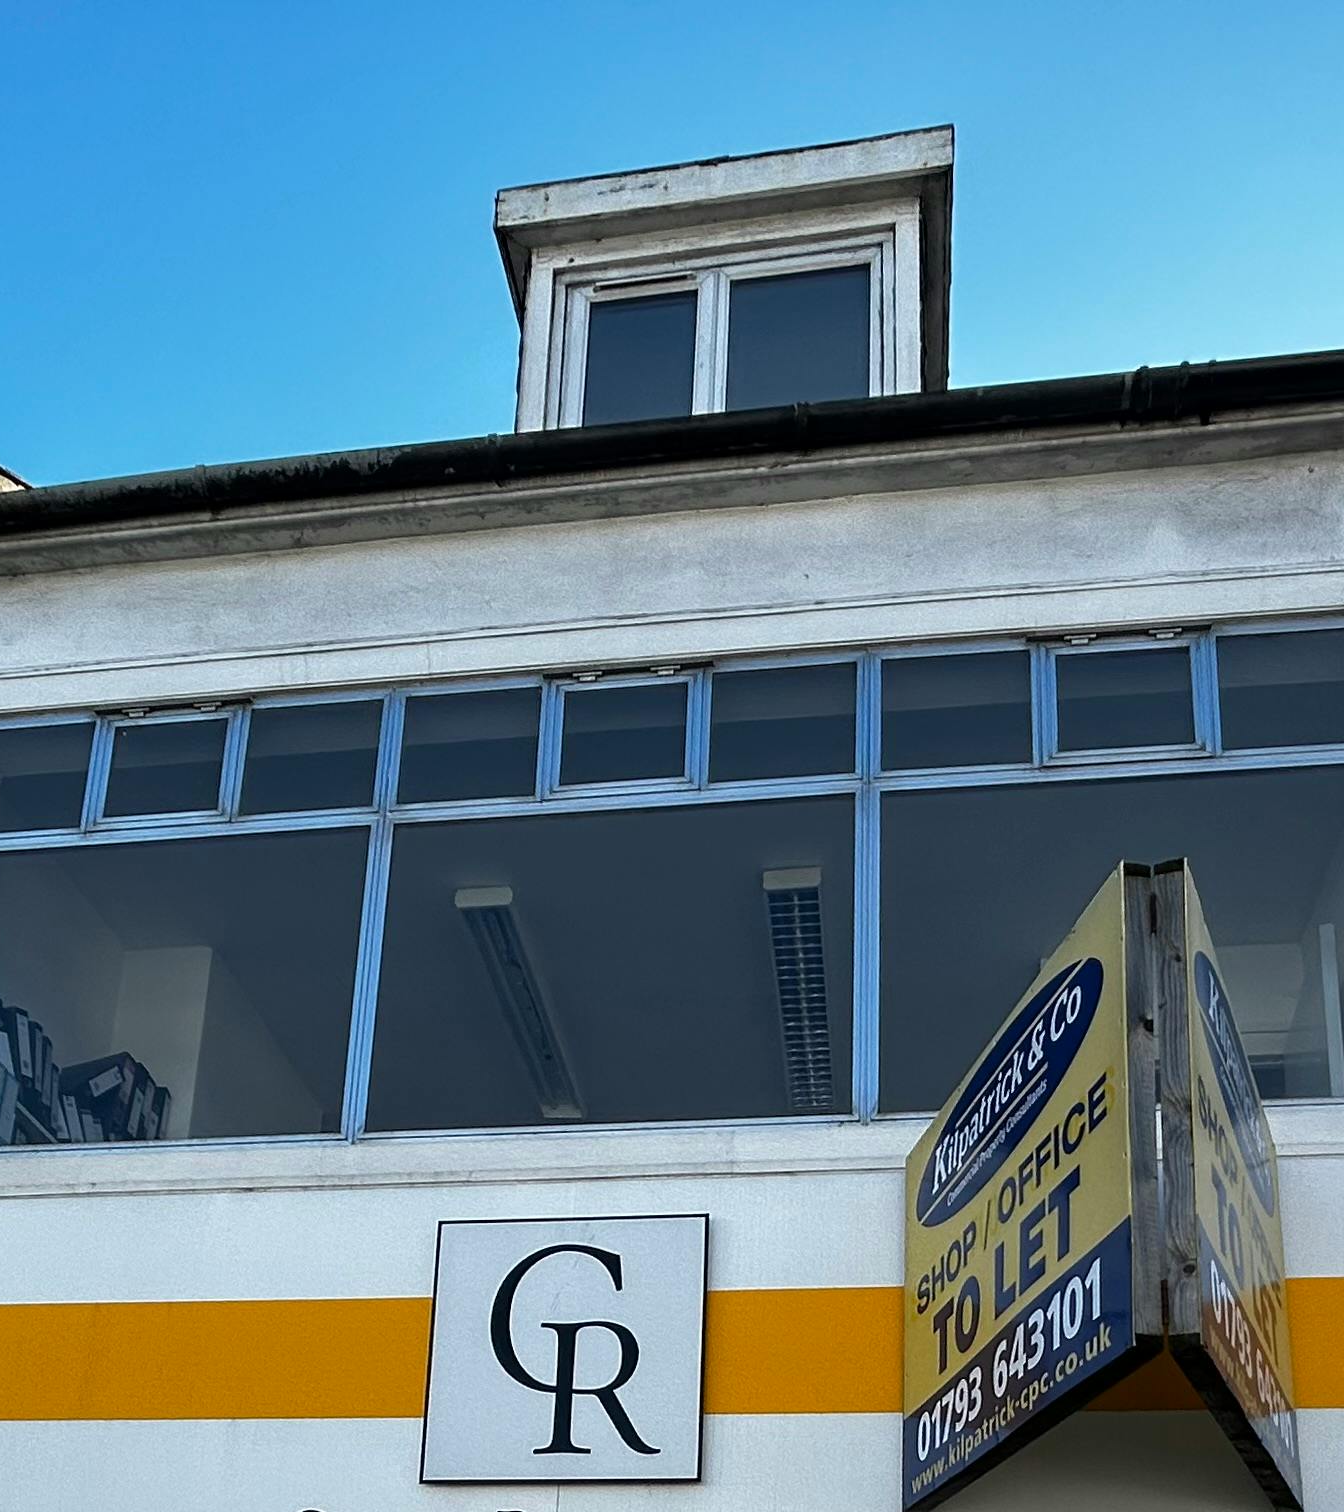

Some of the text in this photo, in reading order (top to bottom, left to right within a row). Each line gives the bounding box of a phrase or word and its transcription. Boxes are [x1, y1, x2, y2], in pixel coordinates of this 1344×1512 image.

[932, 984, 1082, 1195] Kilpatrick & Co
[1197, 1073, 1237, 1188] SHOP
[916, 1215, 976, 1320] SHOP
[997, 1072, 1108, 1226] OFFICE
[933, 1162, 1080, 1381] TO LET
[1211, 1160, 1244, 1290] TO
[1250, 1235, 1279, 1368] LET
[911, 1323, 1112, 1497] www.kilpatrick-cpc.co.uk
[917, 1362, 983, 1464] 01793
[992, 1257, 1103, 1400] 643101
[1211, 1258, 1252, 1380] 01793
